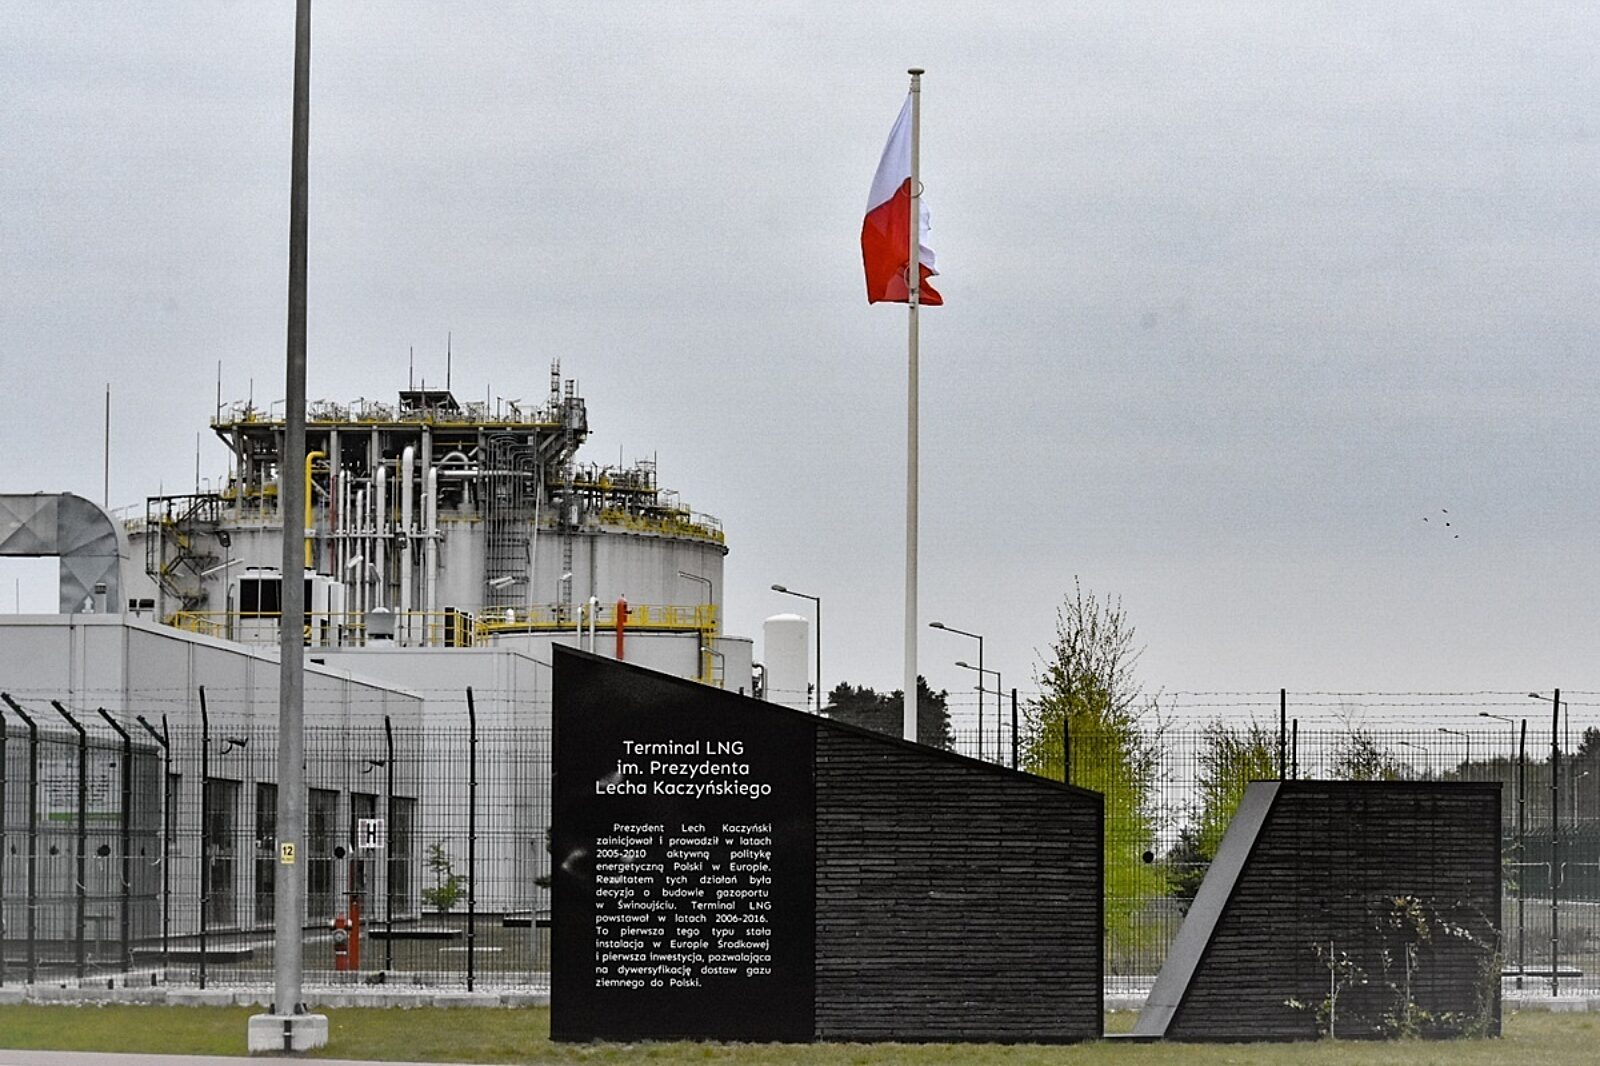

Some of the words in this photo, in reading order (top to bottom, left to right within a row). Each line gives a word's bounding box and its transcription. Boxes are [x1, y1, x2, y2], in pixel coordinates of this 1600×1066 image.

[623, 740, 699, 755] Terminal
[707, 741, 743, 755] LNG
[617, 760, 643, 775] im.
[651, 760, 749, 779] Prezydenta
[596, 780, 646, 794] Lecha
[654, 780, 771, 799] Kaczyńskiego
[367, 823, 376, 843] H
[614, 823, 664, 834] Prezydent
[682, 824, 705, 832] Lech
[723, 823, 771, 834] Kaczyński
[597, 836, 652, 847] zainicjował
[659, 836, 663, 845] i
[669, 836, 719, 847] prowadził
[725, 838, 733, 846] w
[740, 837, 771, 845] latach
[283, 846, 293, 855] 12
[597, 849, 646, 858] 2005-2010
[667, 850, 709, 860] aktywną
[731, 849, 771, 860] politykę
[596, 861, 664, 873] energetyczną
[674, 862, 702, 871] Polski
[712, 863, 720, 871] w
[730, 862, 771, 873] Europie.
[596, 875, 653, 884] Rezultatem
[666, 876, 687, 886] tych
[700, 875, 737, 884] działań
[750, 875, 771, 886] była
[596, 887, 634, 900] decyzja
[644, 889, 650, 898] o
[662, 888, 704, 897] budowie
[716, 890, 768, 899] gazoportu
[596, 902, 604, 910] w
[618, 899, 676, 911] Świnoujściu.
[691, 901, 735, 910] Terminal
[749, 902, 771, 910] LNG
[596, 914, 649, 924] powstawał
[658, 915, 666, 923] w
[675, 914, 706, 922] latach
[716, 914, 768, 922] 2006-2016.
[596, 926, 608, 935] To
[621, 926, 664, 937] pierwsza
[677, 928, 700, 938] tego
[712, 928, 734, 939] typu
[746, 927, 771, 935] stała
[596, 939, 644, 950] instalacja
[653, 941, 661, 949] w
[670, 939, 708, 950] Europie
[718, 938, 769, 950] Środkowej
[595, 952, 600, 961] i
[602, 952, 646, 963] pierwsza
[650, 952, 704, 963] inwestycja,
[708, 952, 771, 963] pozwalająca
[618, 965, 691, 976] dywersyfikację
[701, 966, 737, 974] dostaw
[746, 967, 771, 977] gazu
[596, 978, 644, 989] ziemnego
[650, 978, 663, 987] do
[670, 978, 701, 987] Polski.
